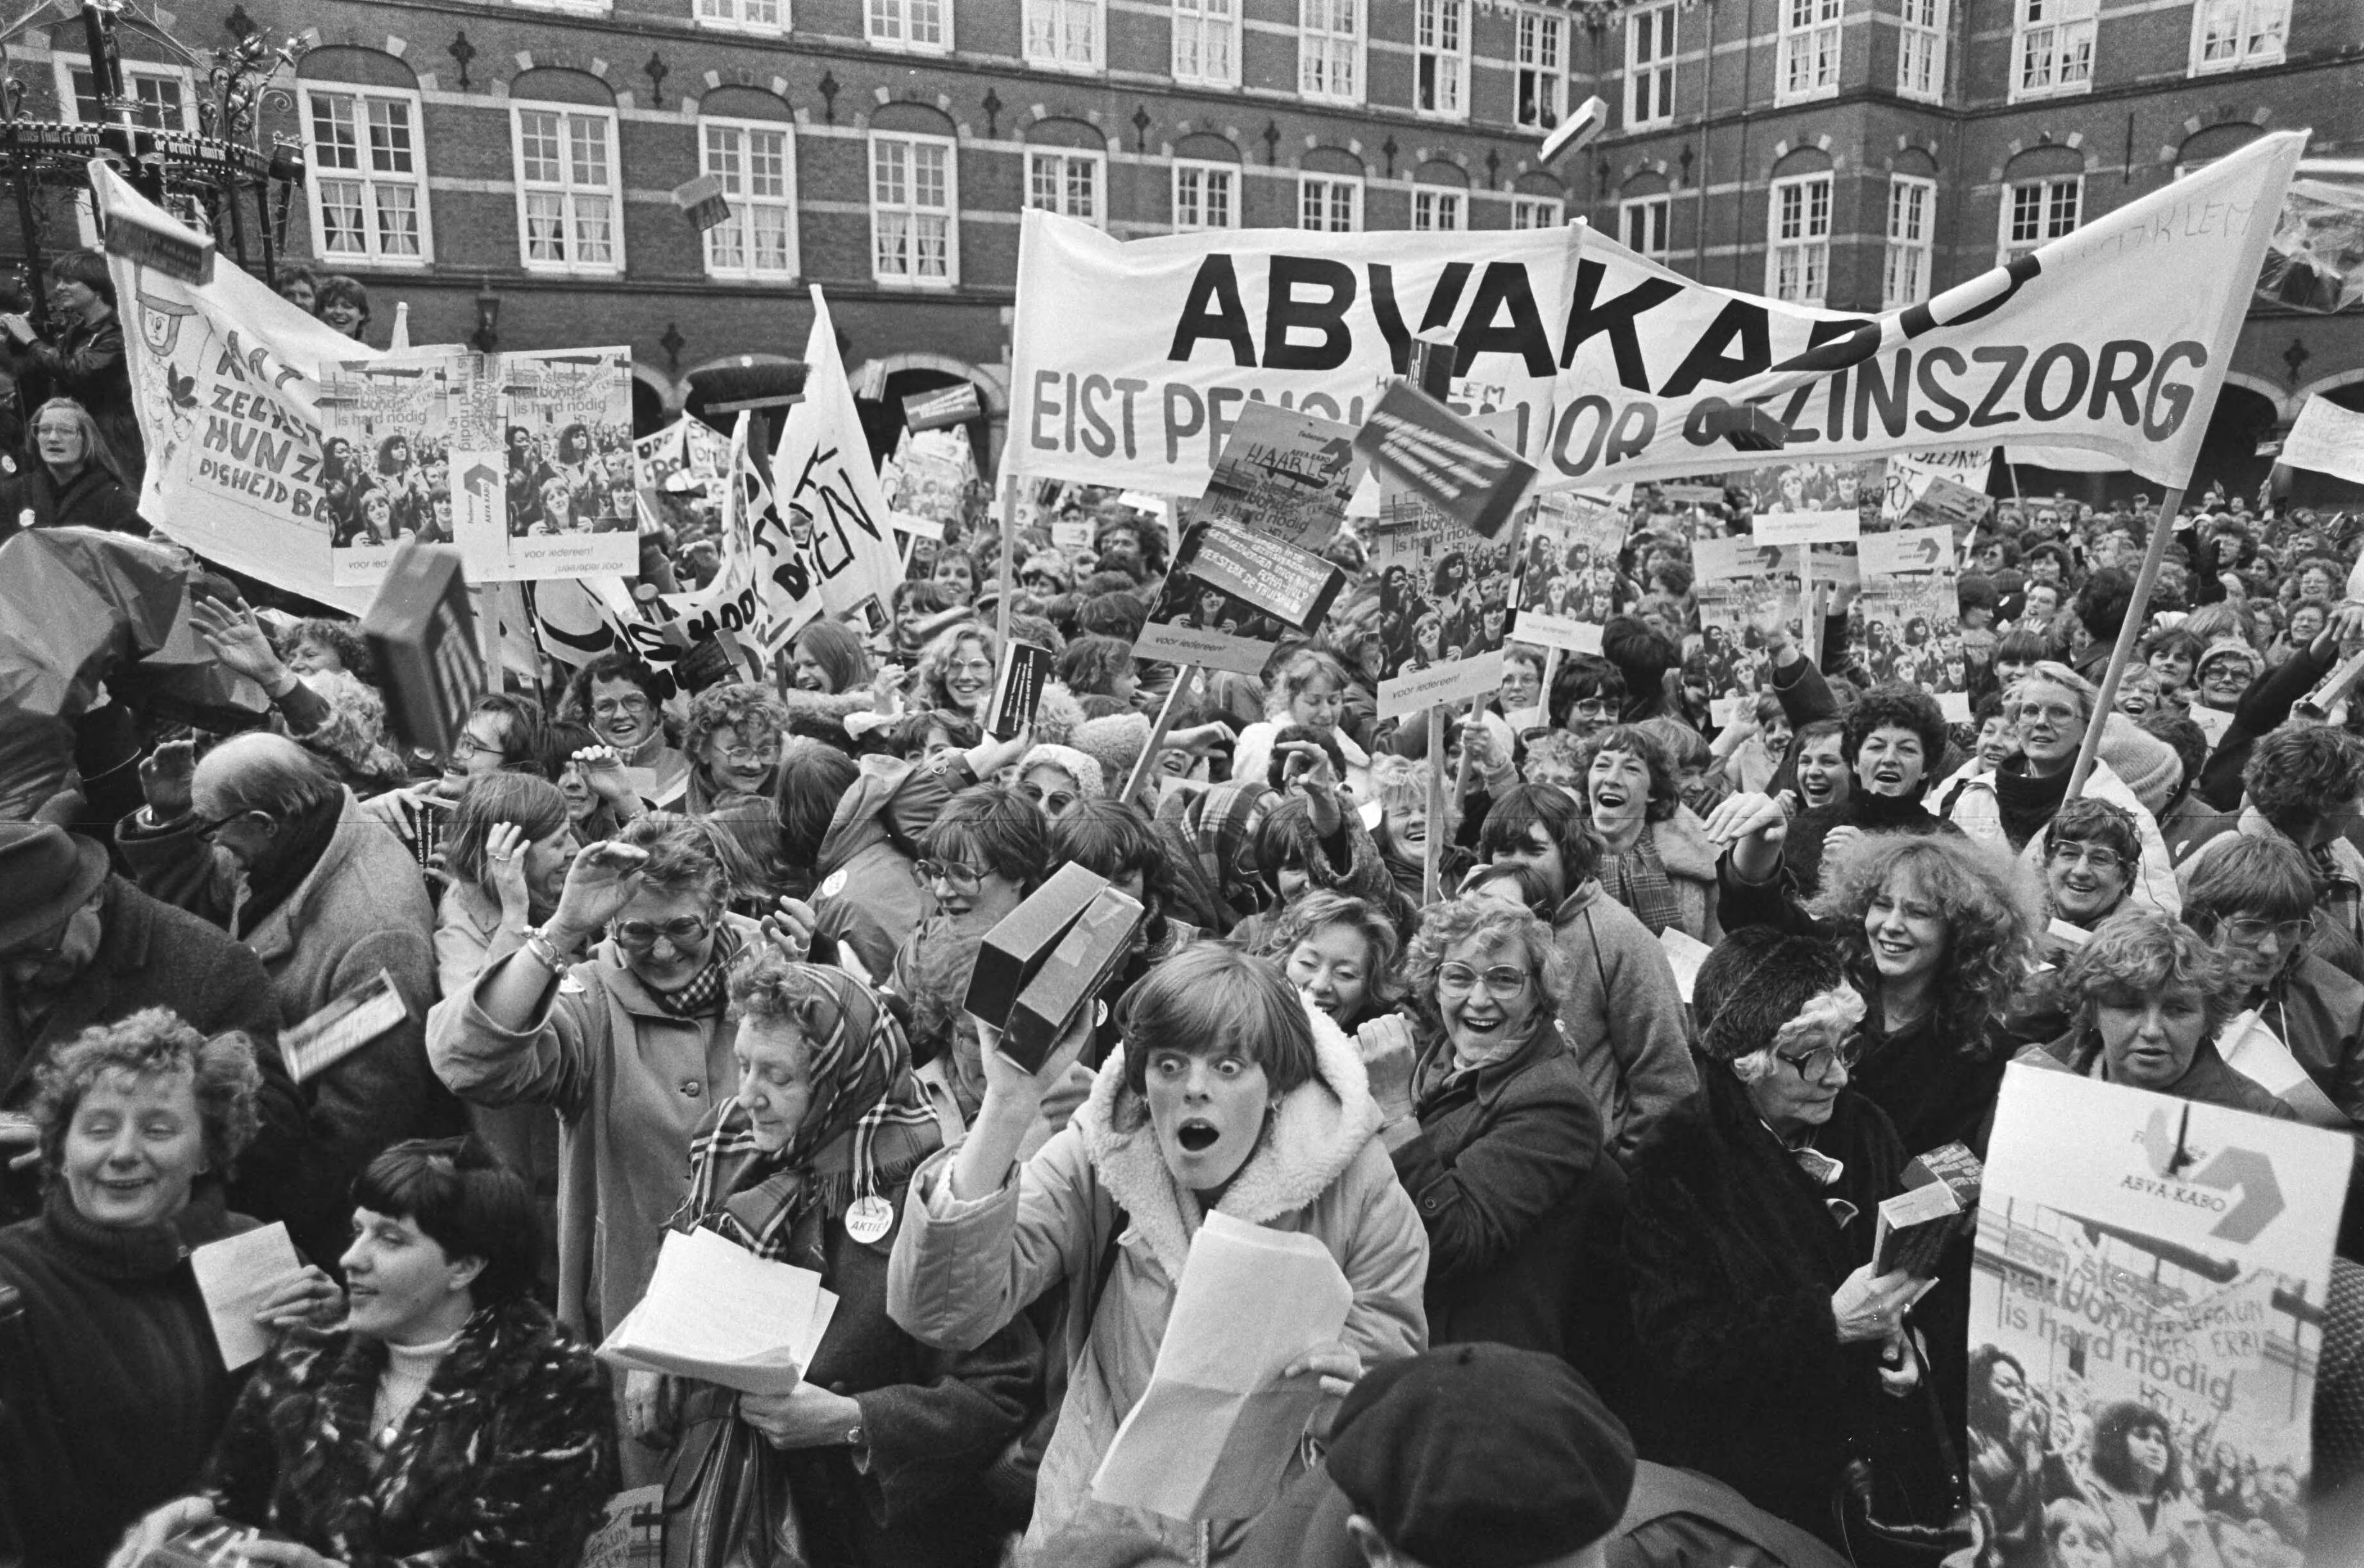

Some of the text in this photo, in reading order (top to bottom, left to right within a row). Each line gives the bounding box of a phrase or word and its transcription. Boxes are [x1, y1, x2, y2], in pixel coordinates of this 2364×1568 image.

[568, 397, 606, 414] nodig
[1030, 370, 1149, 460] EIST
[204, 415, 291, 474] HUN
[524, 550, 547, 559] voor
[1392, 686, 1414, 699] voor
[2006, 1296, 2028, 1331] is
[2038, 1308, 2114, 1363] hard
[2125, 1346, 2238, 1412] nodig
